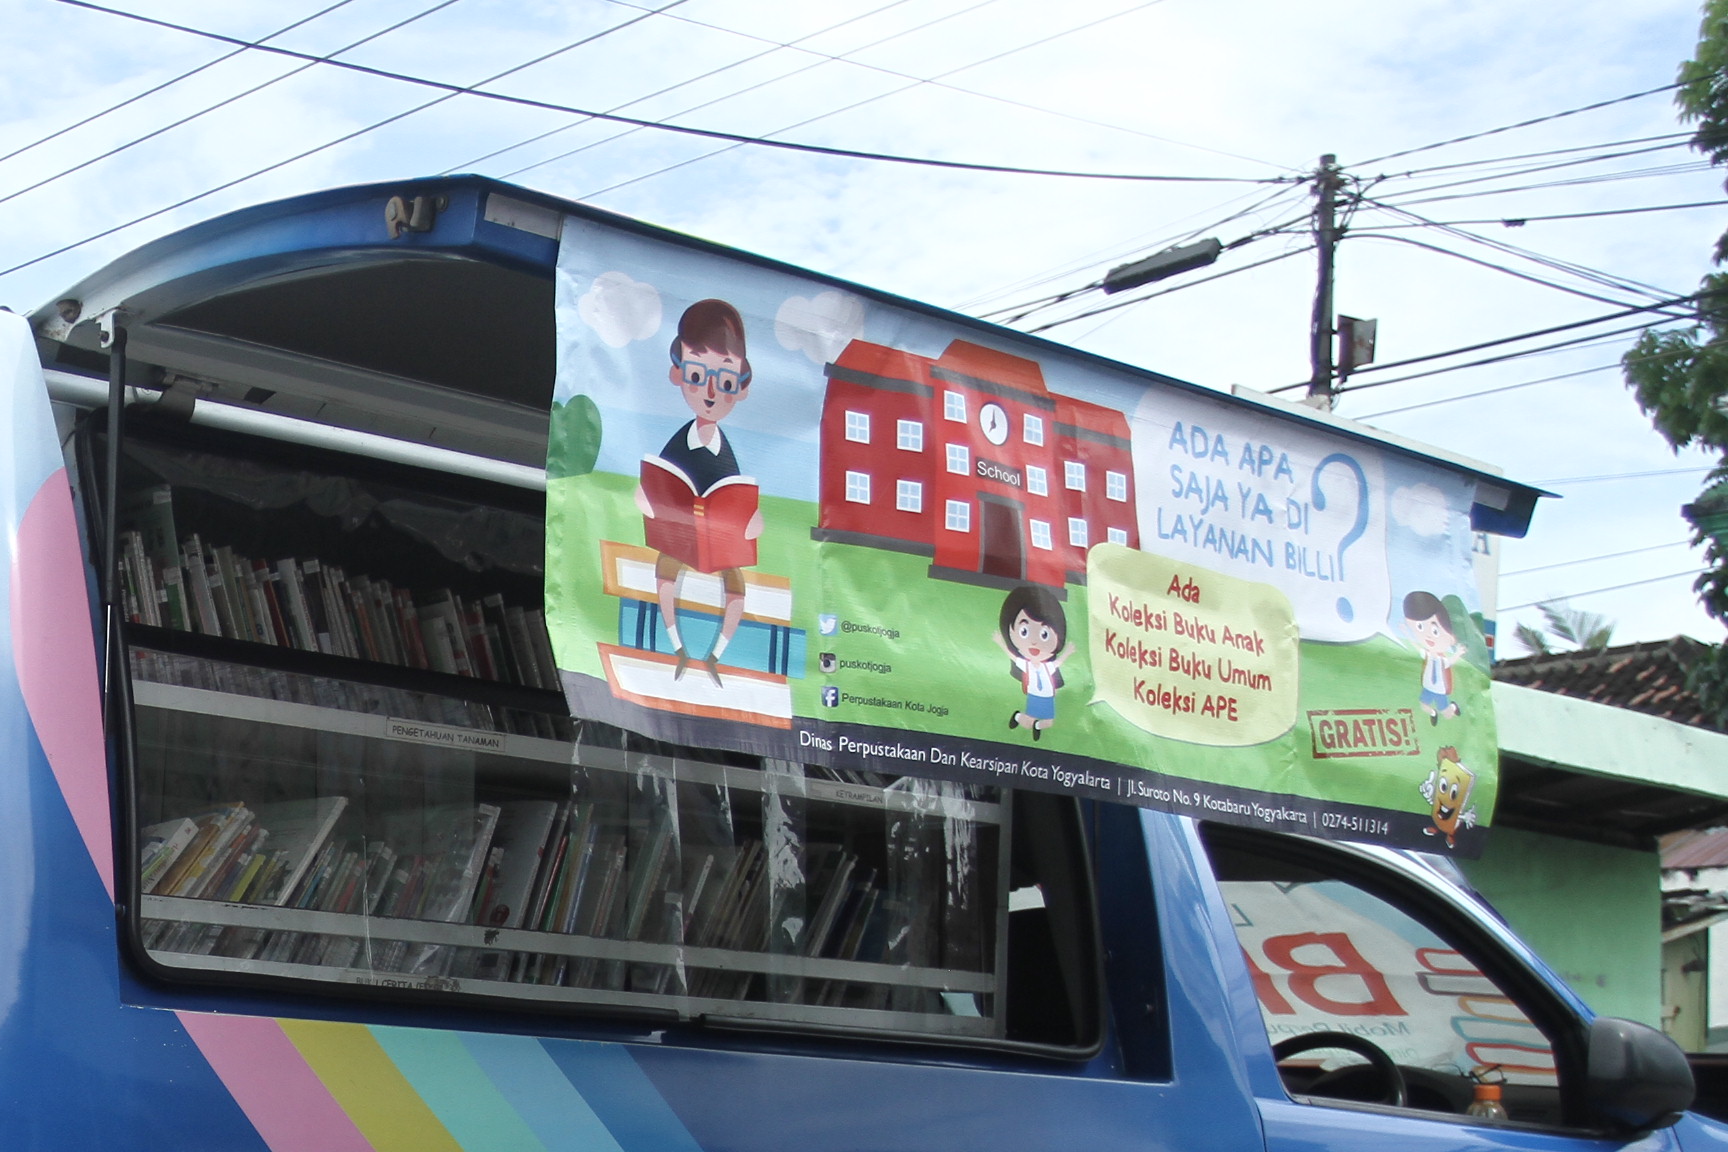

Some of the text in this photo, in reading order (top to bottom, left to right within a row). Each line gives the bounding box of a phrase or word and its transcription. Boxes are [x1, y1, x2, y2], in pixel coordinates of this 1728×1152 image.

[977, 461, 1021, 486] School
[1169, 421, 1294, 484] ADA APA
[1170, 464, 1309, 535] SAJA YA DI
[1157, 507, 1335, 582] LAYANAN BILLI
[1167, 574, 1200, 604] Ada
[841, 620, 900, 639] @puskotjogja
[1109, 592, 1265, 657] Koleksi Buku Anak
[839, 659, 892, 674] puskotjogja
[1105, 628, 1272, 691] Koleksi Buku Umum
[841, 693, 949, 717] Perpustakaan Kota Jogja
[1133, 677, 1238, 722] Koleksi APE
[392, 725, 499, 748] PENGETAHUAN TANAMAN
[799, 730, 833, 751] Dinas
[839, 736, 926, 762] Perpustakaan
[930, 747, 956, 766] Dan
[961, 752, 1018, 776] Kearsipan
[1021, 760, 1048, 780] Kota
[1319, 718, 1410, 749] GRATIS!
[1138, 783, 1170, 802] Suroto
[1173, 789, 1192, 806] No.
[1193, 791, 1200, 806] 9
[1203, 794, 1250, 815] Kotabaru
[1251, 801, 1307, 824] Yogyakarta
[1322, 812, 1388, 835] 0274-511314
